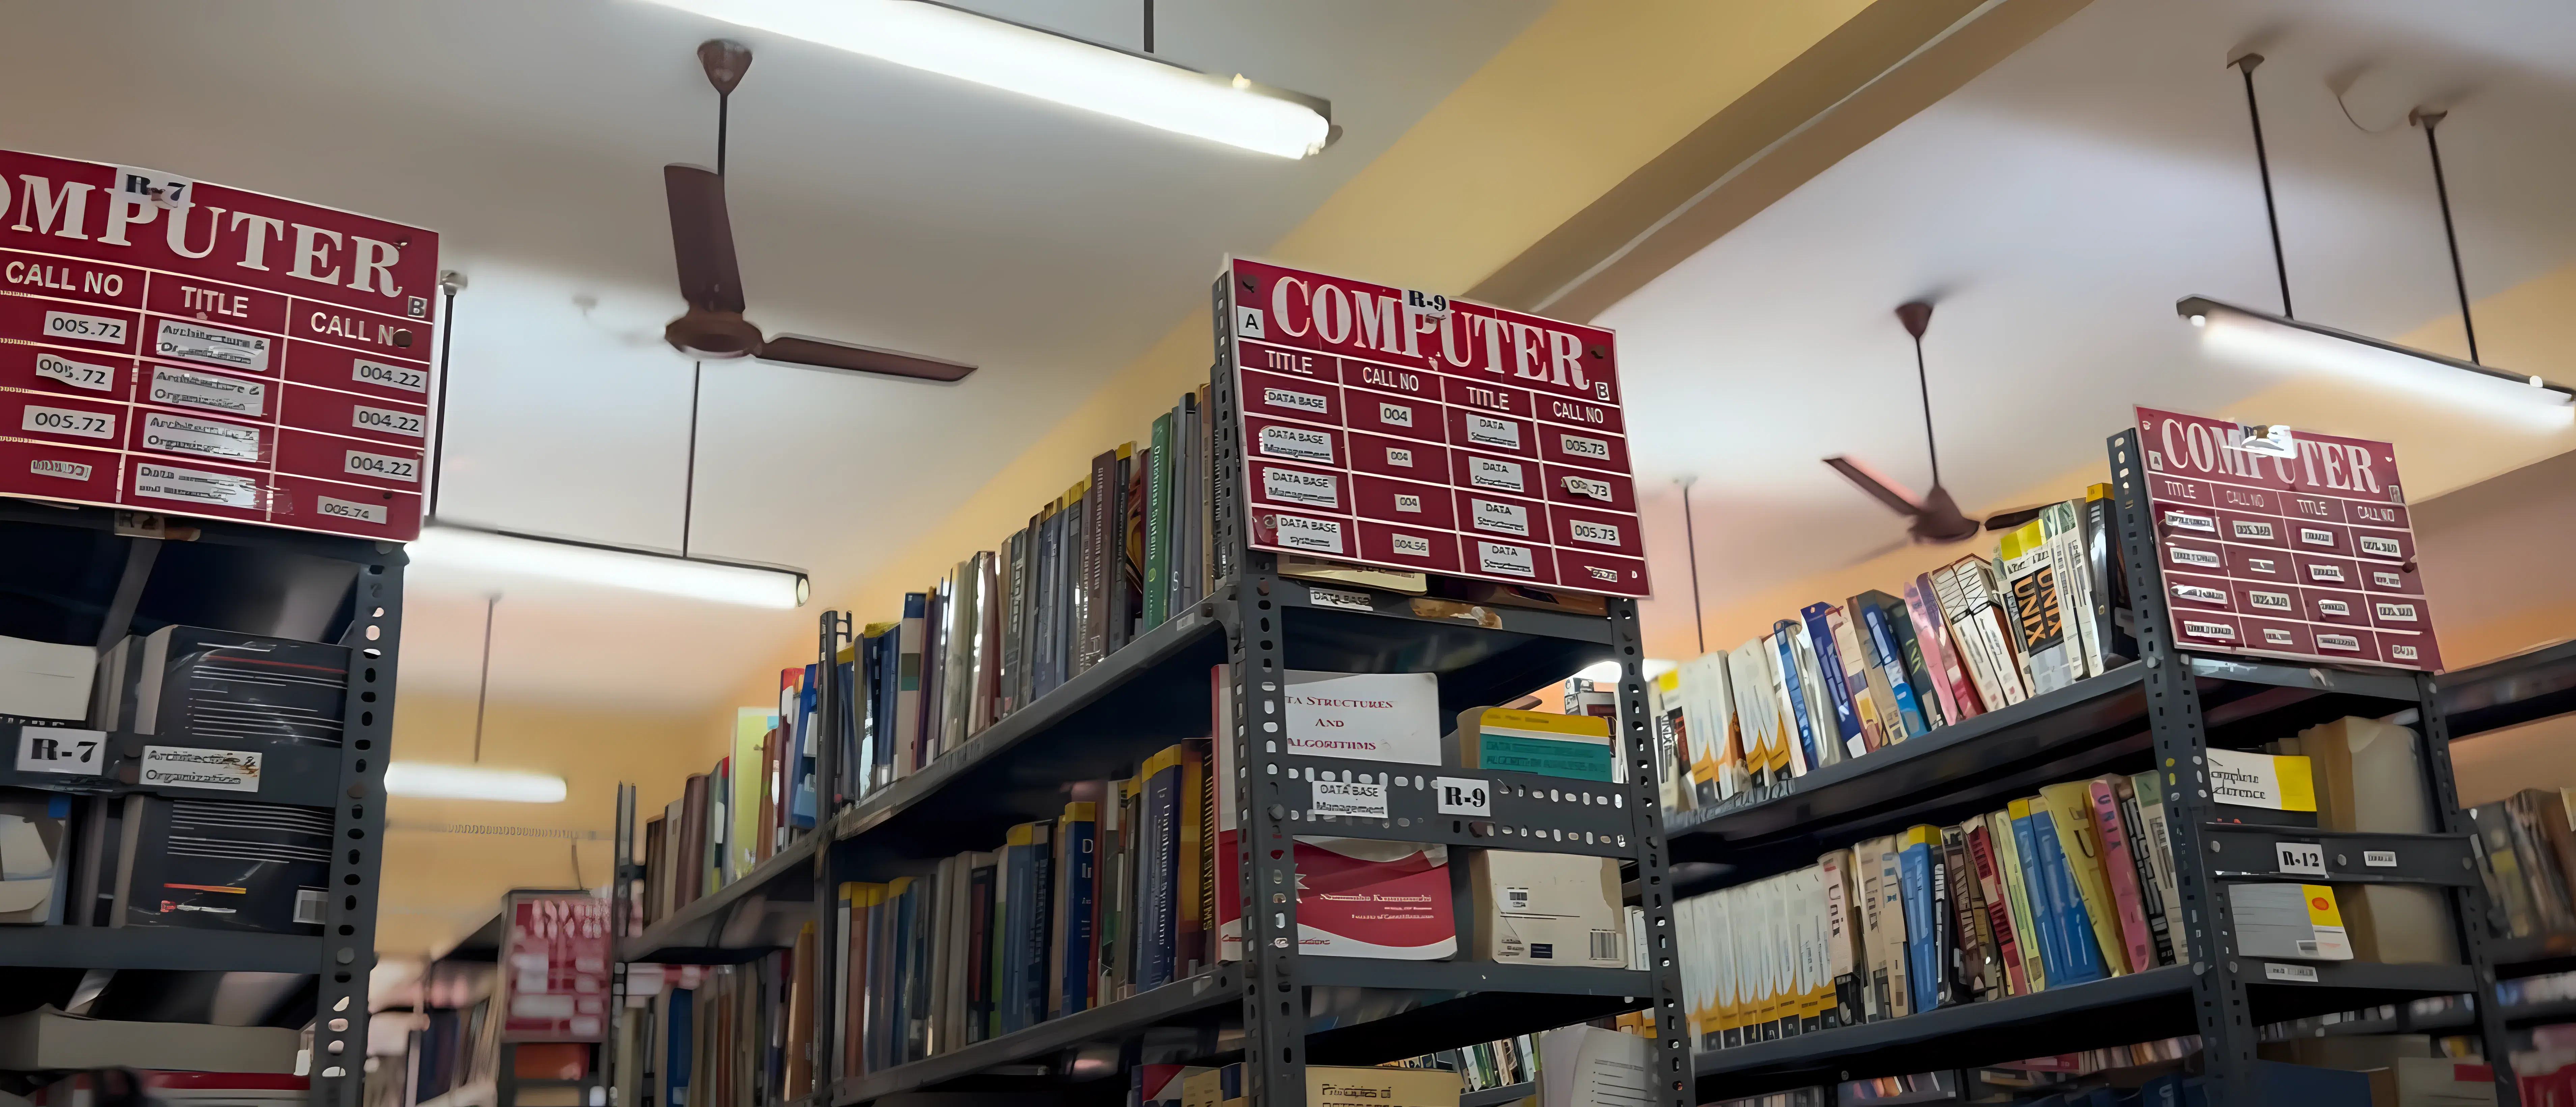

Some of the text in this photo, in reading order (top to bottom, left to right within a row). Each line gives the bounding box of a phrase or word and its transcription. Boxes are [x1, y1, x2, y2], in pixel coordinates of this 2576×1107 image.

[125, 174, 186, 200] R7
[6, 262, 123, 296] CALL NO
[181, 286, 248, 317] TITLE
[412, 299, 424, 315] B
[1408, 290, 1446, 311] R-9
[53, 318, 121, 338] 005.72
[311, 312, 412, 348] CALL N
[1245, 314, 1259, 330] A
[1272, 276, 1589, 390] COMPUTER
[1265, 350, 1313, 374] TITLE
[361, 366, 420, 387] 004.22
[1363, 367, 1419, 391] CALL NO
[1268, 392, 1324, 408] DATA BASE
[1466, 387, 1510, 410] TITLE
[1597, 384, 1608, 398] B
[35, 413, 105, 432] 005.72
[359, 411, 419, 432] 004.22
[1384, 408, 1407, 421] 004
[1553, 402, 1603, 424] CALL NO
[1480, 419, 1505, 430] DATA
[1268, 429, 1324, 444] DATA BASE
[1565, 440, 1605, 455] 005.73
[351, 456, 412, 477] 004.22
[1483, 463, 1509, 473] DATA
[1273, 473, 1329, 487] DATA BASE
[2165, 481, 2196, 498] TITLE
[1486, 504, 1512, 515] DATA
[2297, 500, 2328, 515] TITLE
[1281, 518, 1337, 533] DATA BASE
[1575, 525, 1616, 540] 005.73
[1492, 545, 1518, 556] DATA
[2037, 566, 2062, 637] UNIX
[2015, 575, 2046, 648] UNIX
[1315, 719, 1344, 727] AND
[33, 738, 97, 763] R-7
[1320, 785, 1378, 797] DATA BASE
[1445, 786, 1485, 807] R-9
